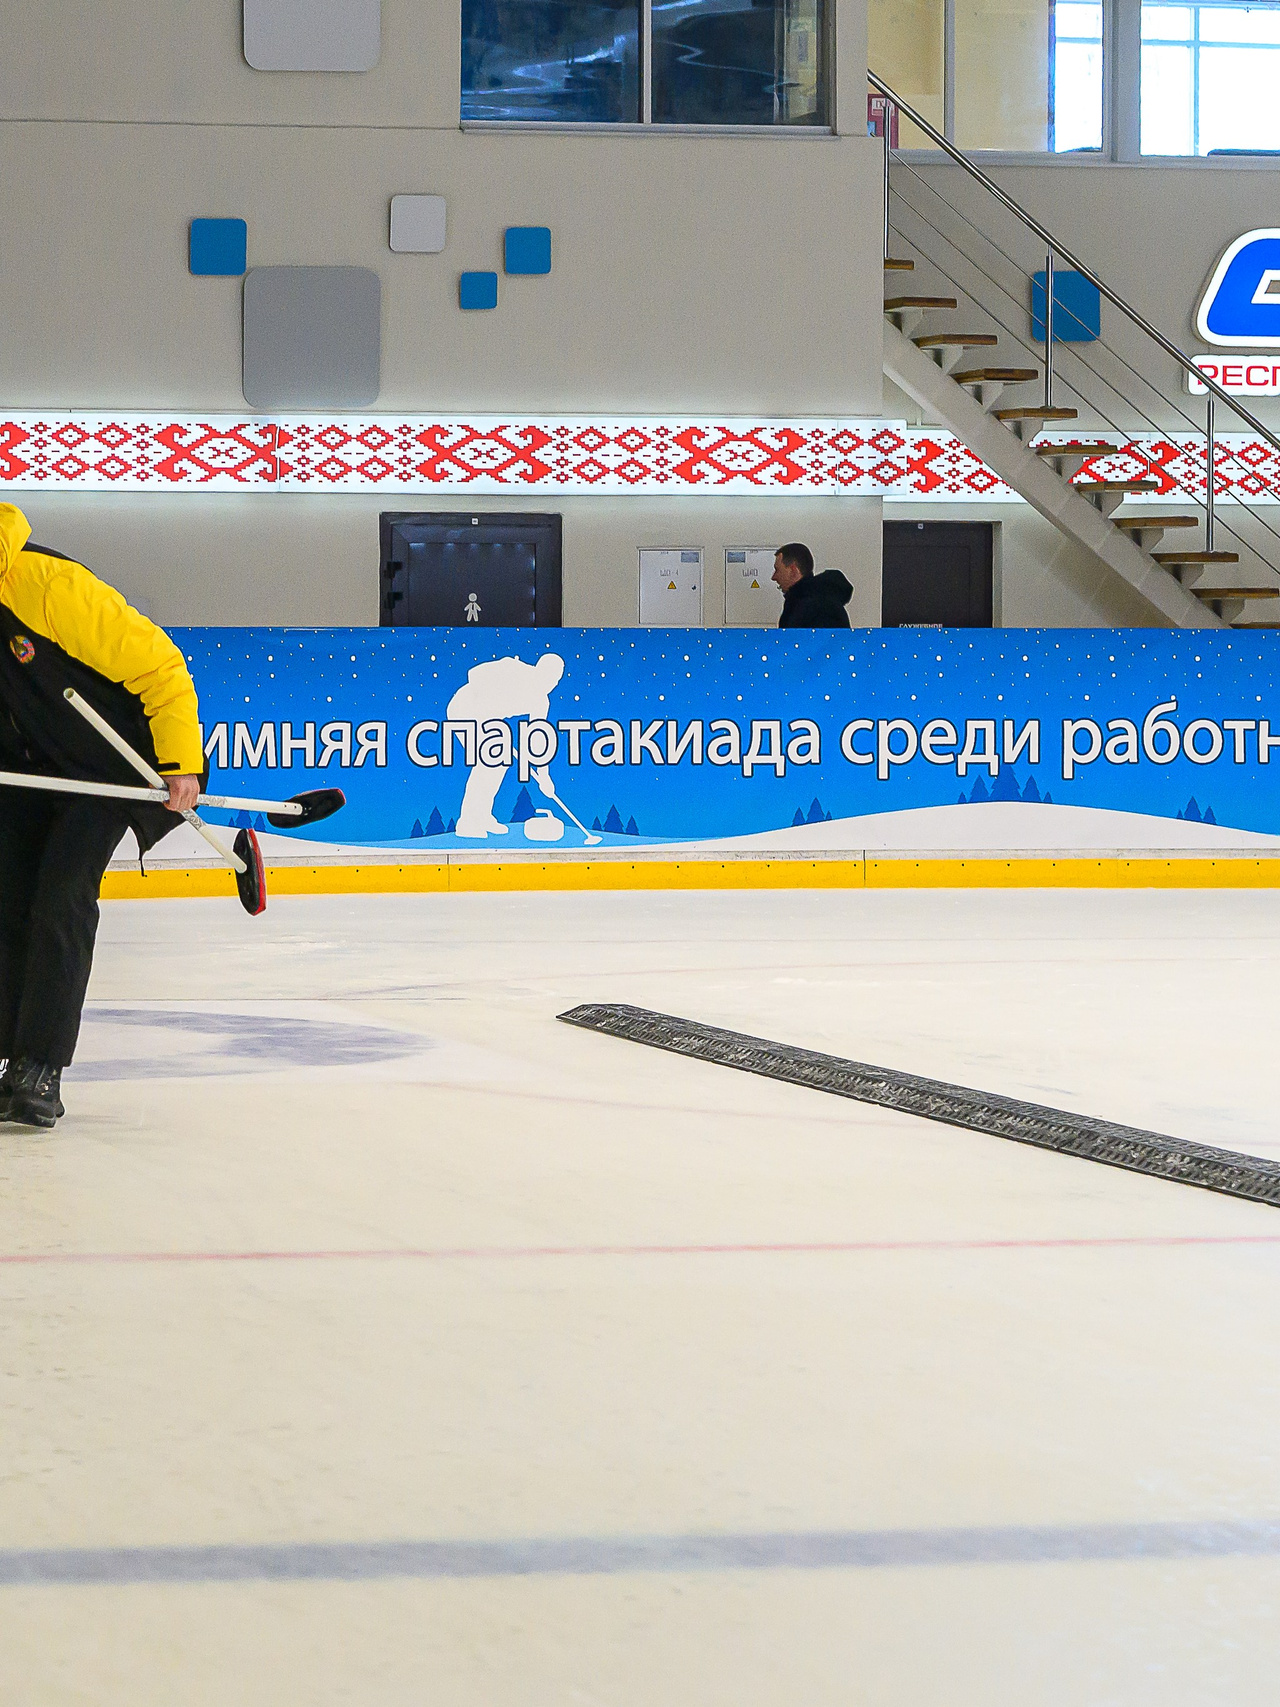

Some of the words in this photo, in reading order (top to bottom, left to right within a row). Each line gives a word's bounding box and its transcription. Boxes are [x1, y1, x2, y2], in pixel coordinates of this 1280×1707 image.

[198, 720, 388, 769] имняя
[406, 717, 821, 782] спартакиада
[840, 717, 1042, 780] среди
[1061, 700, 1280, 780] работн
